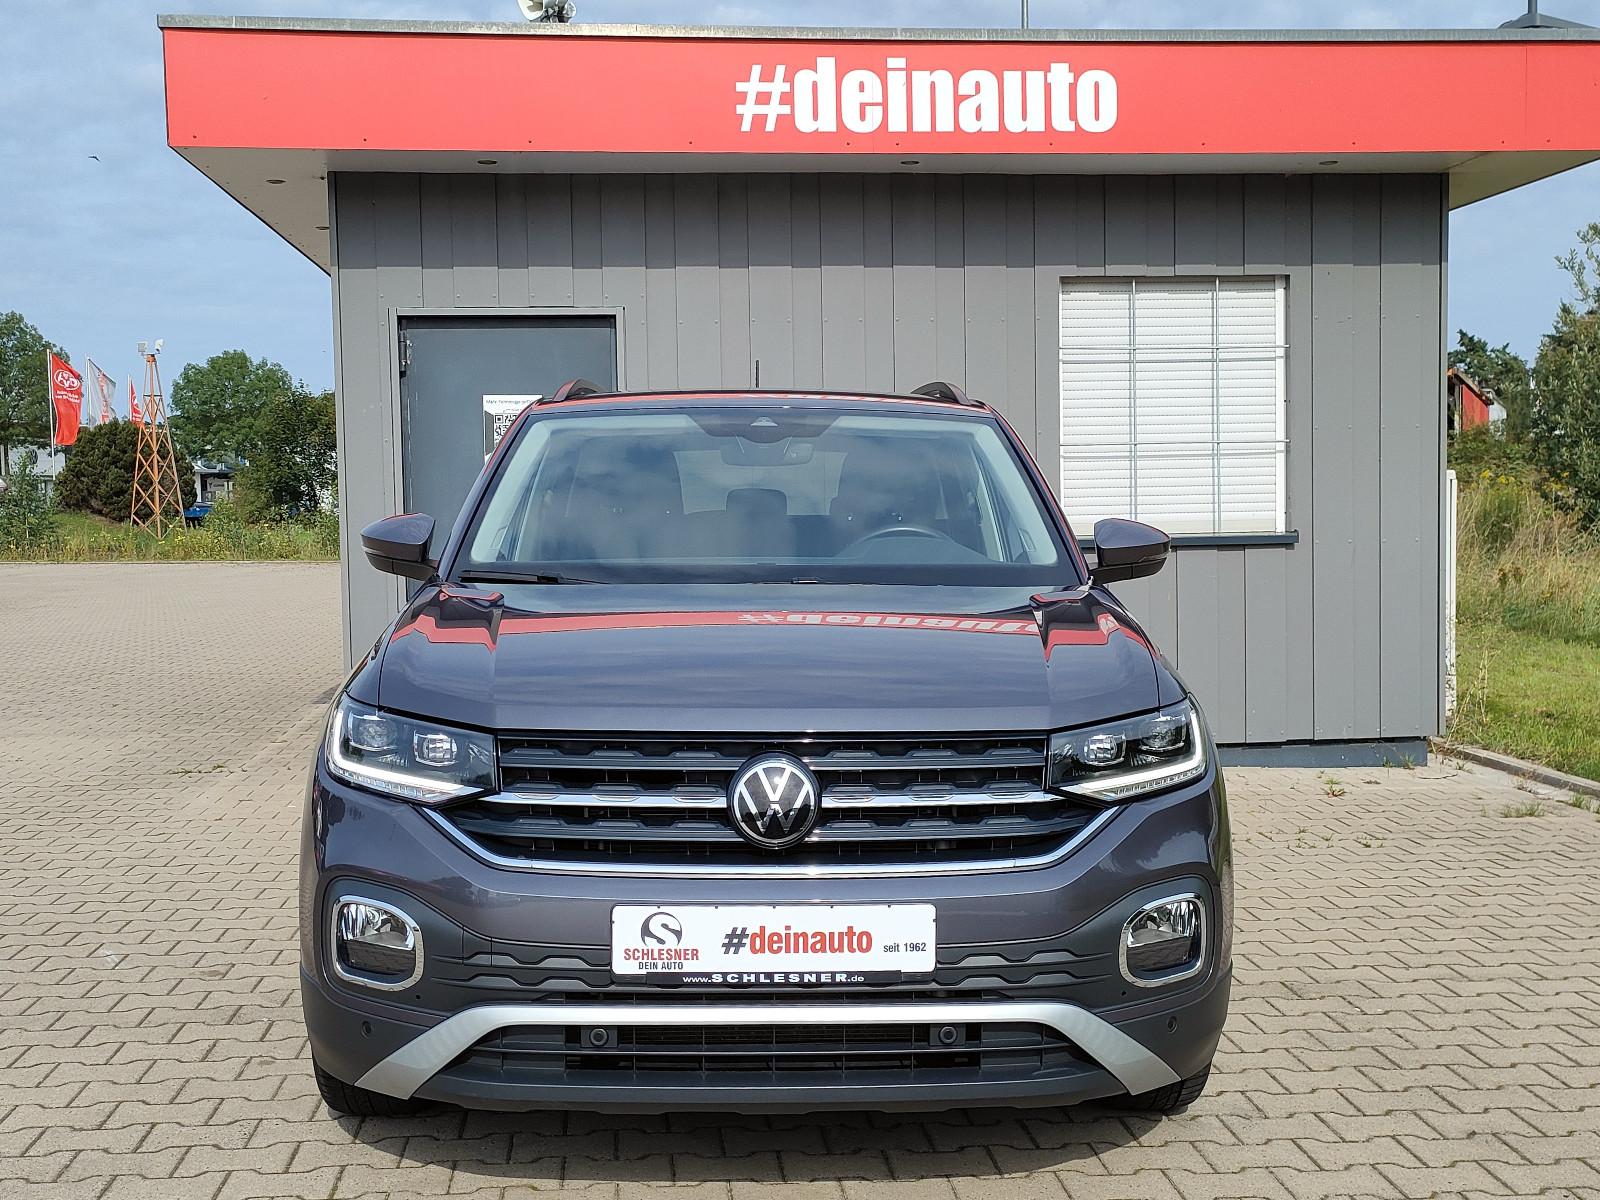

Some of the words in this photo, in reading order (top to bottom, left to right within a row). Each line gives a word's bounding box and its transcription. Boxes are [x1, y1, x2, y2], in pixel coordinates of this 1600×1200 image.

[735, 56, 1118, 133] #deinauto
[721, 926, 873, 955] #deinauto
[883, 943, 900, 953] seit
[904, 942, 926, 952] 1962
[624, 948, 699, 961] SCHLESNER
[638, 962, 659, 970] DEIN
[661, 962, 683, 970] AUTO
[682, 974, 864, 983] www.SCHLESNER.de
